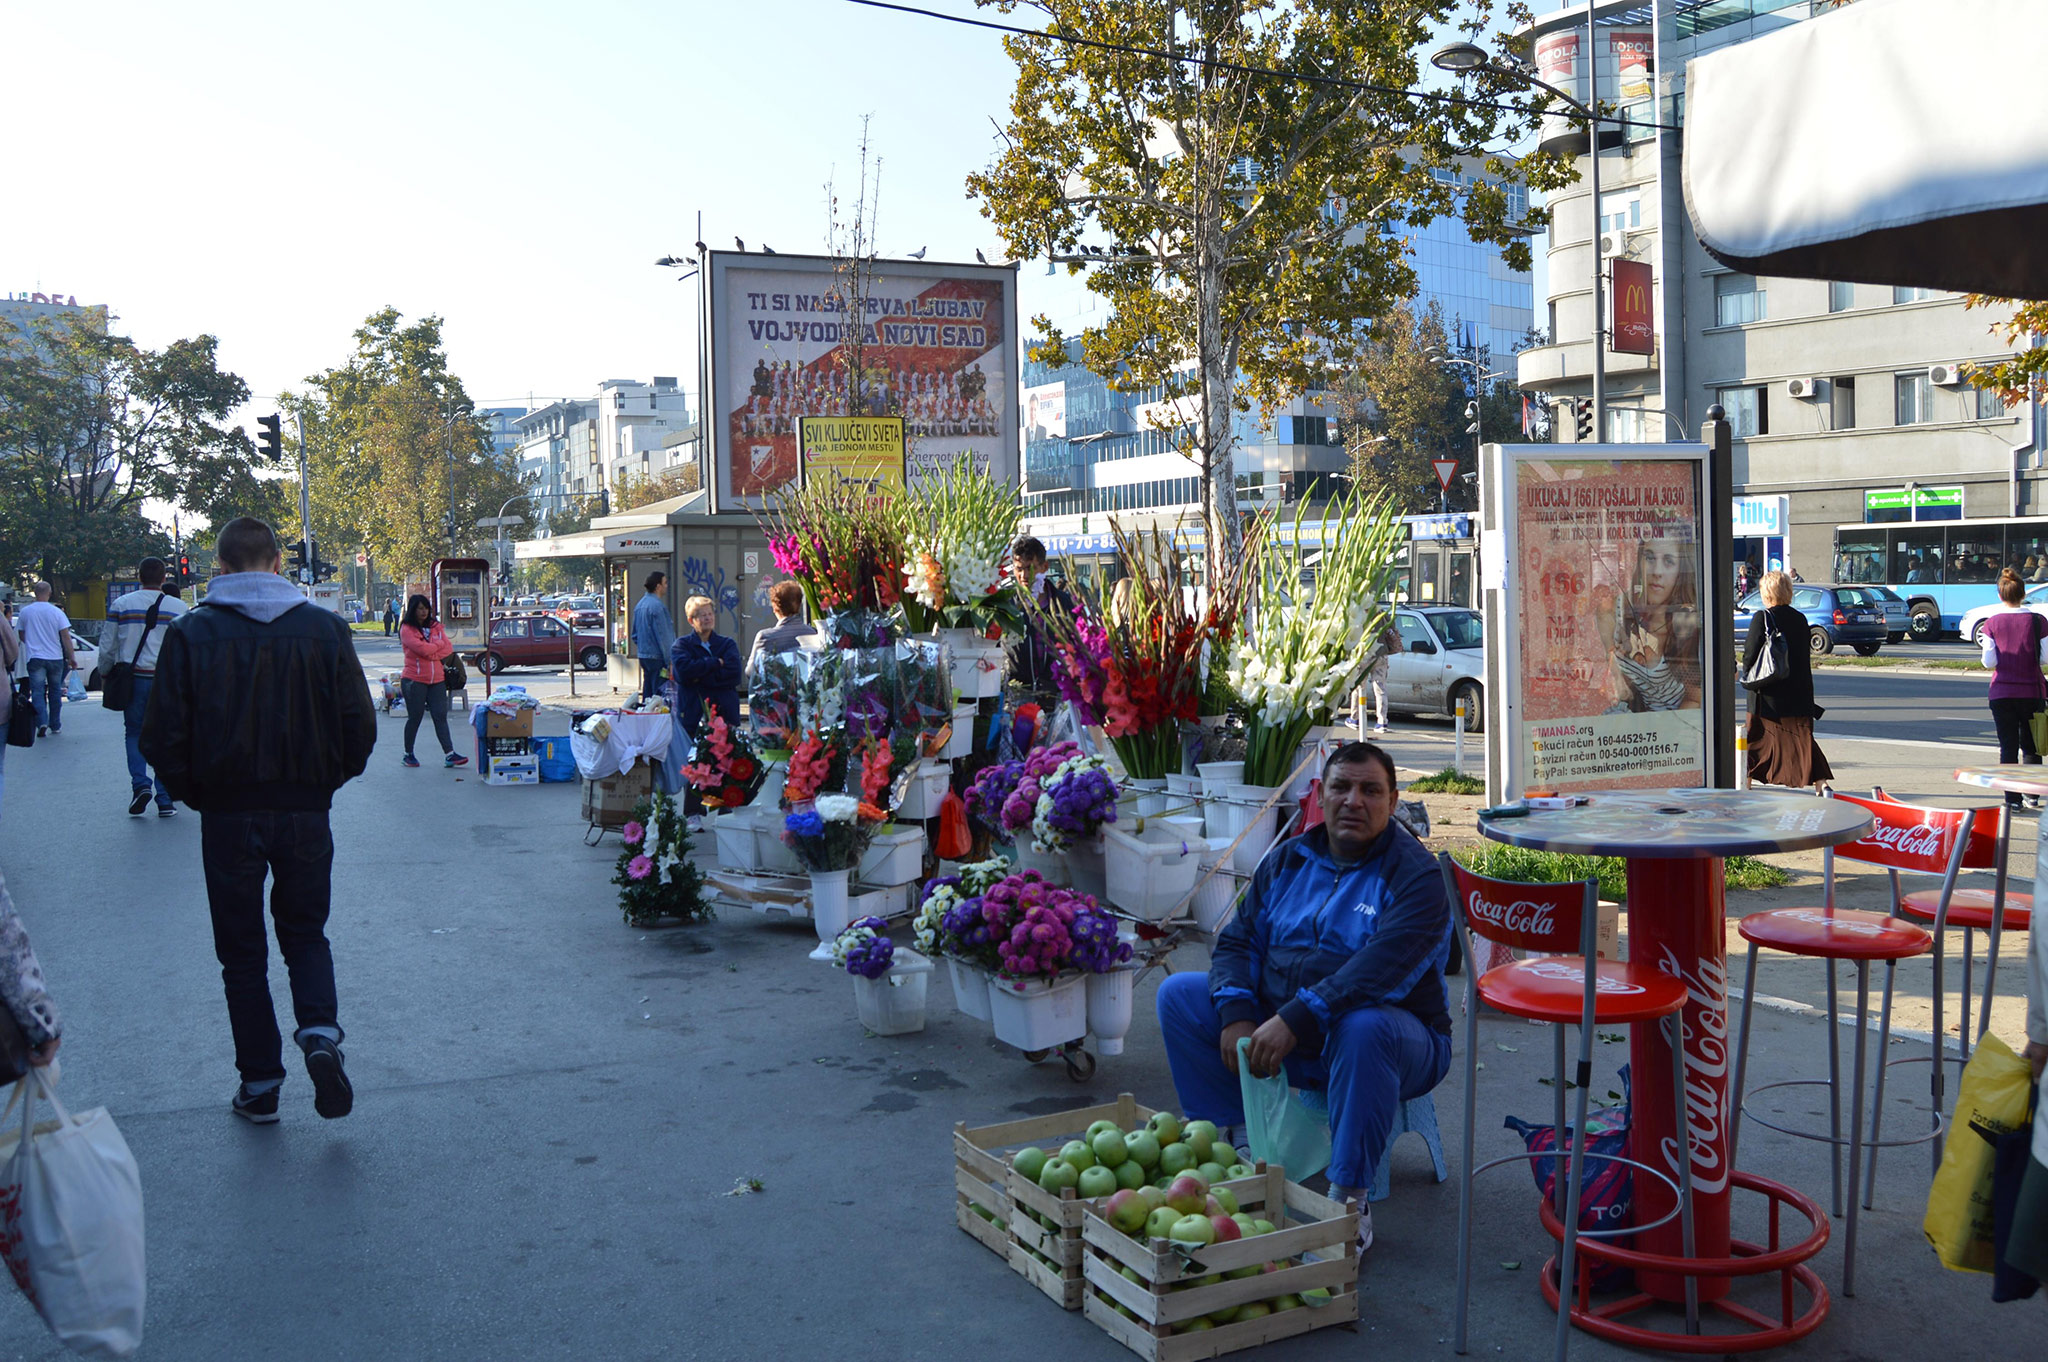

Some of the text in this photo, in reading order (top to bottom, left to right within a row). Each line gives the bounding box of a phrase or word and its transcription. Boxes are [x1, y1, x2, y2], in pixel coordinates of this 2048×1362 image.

[1611, 41, 1654, 53] TOPOL
[747, 293, 769, 311] TI
[772, 294, 790, 311] SI
[851, 297, 905, 315] PRVA
[911, 299, 985, 319] LJUBAV
[883, 323, 937, 346] NOVI
[942, 325, 985, 347] SAD
[805, 420, 900, 443] SVI KLJUČEVI SVETA
[815, 443, 894, 452] NA JEDNOM MESTU
[908, 464, 948, 477] Južn
[1527, 488, 1571, 508] UKUCAJ
[1644, 487, 1659, 506] NA
[1661, 486, 1685, 506] 3030
[1412, 520, 1427, 536] 12
[1430, 521, 1457, 536] RATA
[1540, 572, 1585, 596] 166
[1532, 732, 1658, 752] Tekući račun 160-44529-75
[1533, 752, 1567, 766] Devizni
[1569, 750, 1597, 762] račun
[1533, 767, 1568, 781] PayPal:
